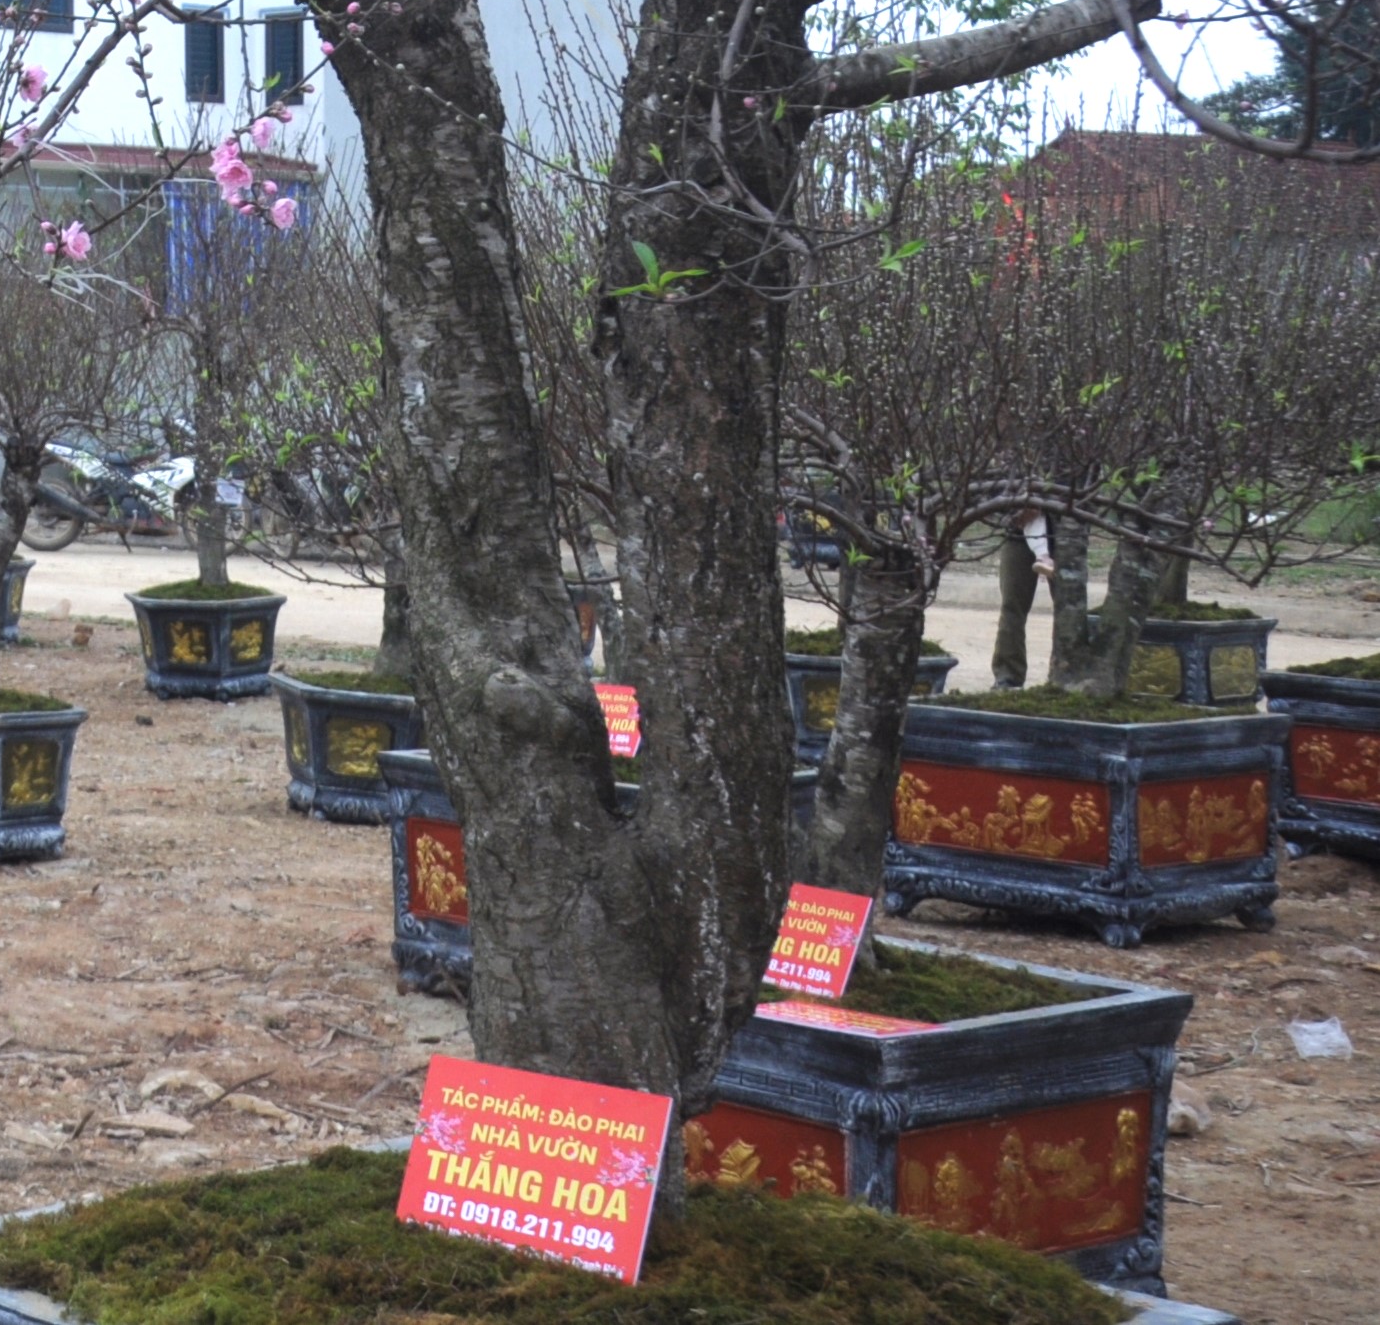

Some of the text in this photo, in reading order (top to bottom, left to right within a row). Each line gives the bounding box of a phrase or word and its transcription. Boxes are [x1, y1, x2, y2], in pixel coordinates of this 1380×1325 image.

[788, 916, 827, 935] VƯỜN
[801, 900, 826, 917] ĐÀO
[827, 908, 855, 923] PHAI
[798, 940, 841, 967] HOA
[768, 959, 832, 984] 8.211.994
[441, 1086, 645, 1143] TÁC PHẨM: ĐÀO PHAI
[470, 1122, 598, 1166] NHÀ VƯỜN
[426, 1149, 628, 1222] THẮNG HOA
[423, 1191, 457, 1217] ĐT:
[459, 1199, 615, 1254] 0918.211.994
